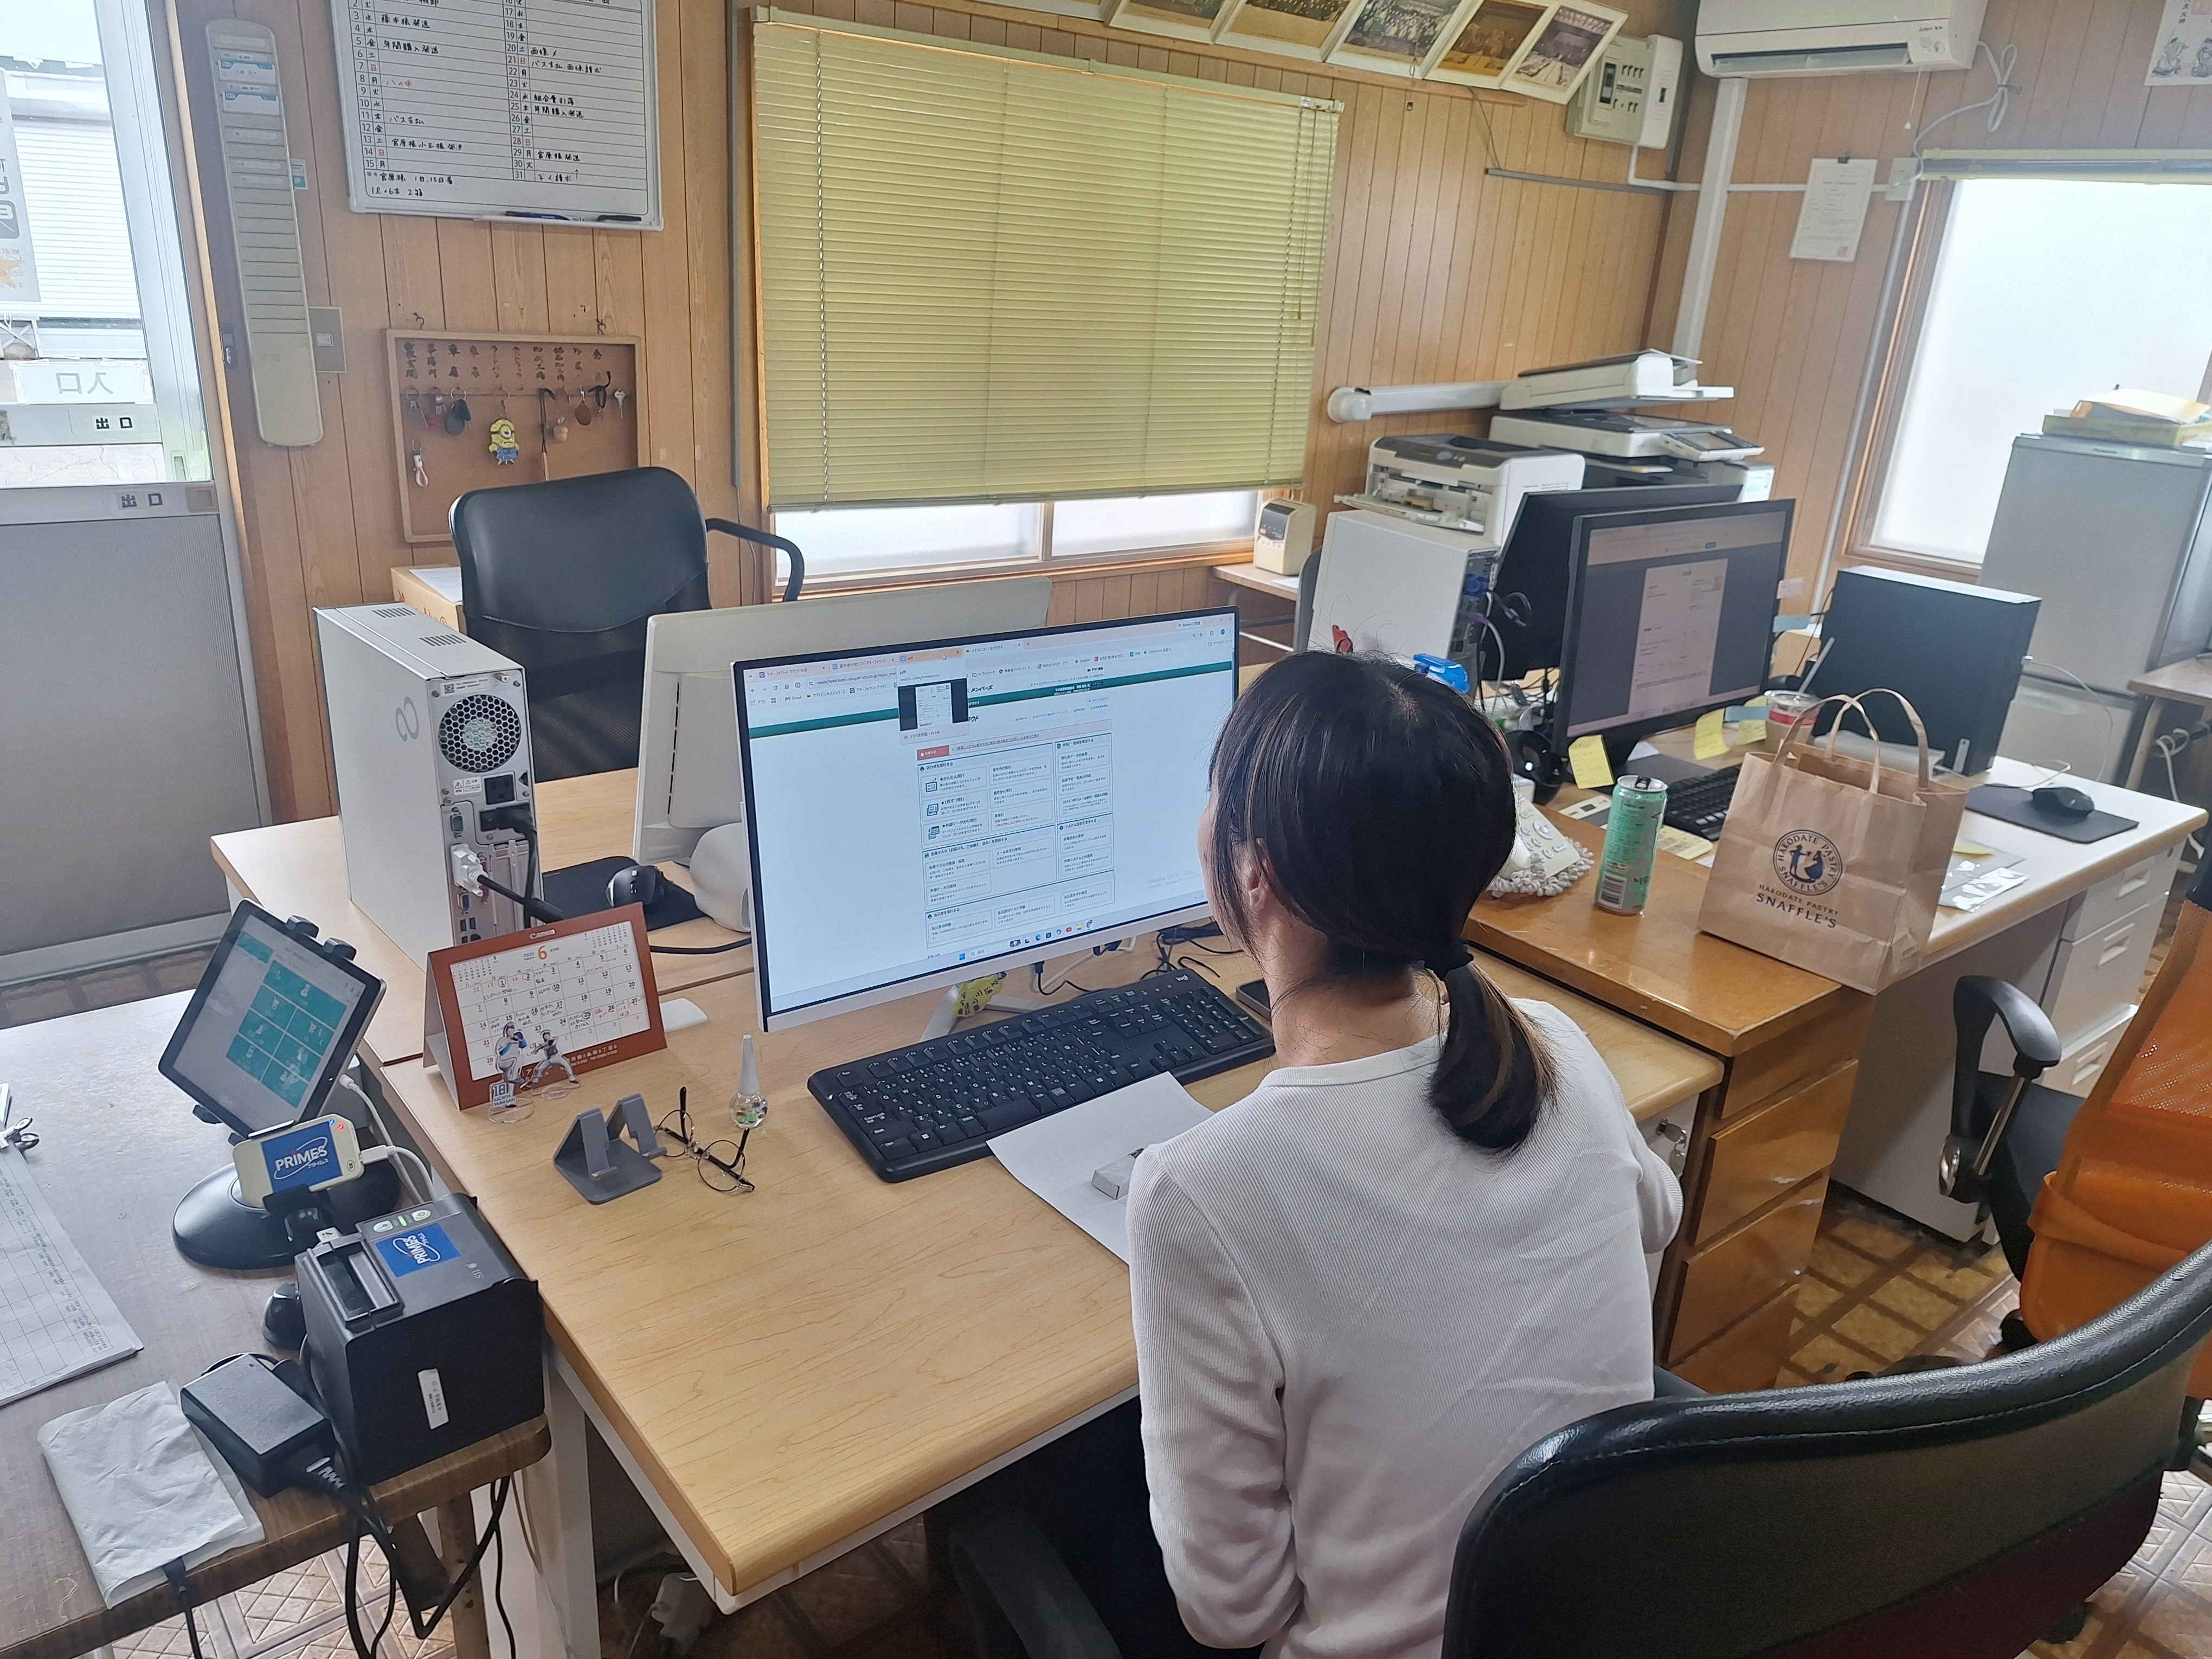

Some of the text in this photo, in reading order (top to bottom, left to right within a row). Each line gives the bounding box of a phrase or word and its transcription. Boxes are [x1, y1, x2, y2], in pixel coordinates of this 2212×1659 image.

[354, 11, 359, 20] 3
[357, 49, 363, 57] 6
[509, 67, 517, 75] 22
[510, 79, 518, 87] 23
[361, 87, 366, 95] 9
[510, 91, 518, 99] 24
[359, 99, 369, 107] 10
[361, 111, 370, 119] 11
[511, 114, 520, 122] 26
[362, 123, 371, 131] 12
[363, 136, 372, 144] 13
[365, 159, 375, 168] 15
[95, 417, 133, 430] 出口
[121, 493, 163, 508] 出口
[1778, 834, 1838, 880] HAKODATE PASTRY
[1779, 866, 1828, 891] SNAFFLE'S
[1759, 884, 1839, 916] HAKODATE PASTRY
[1756, 893, 1837, 928] SNAFFLE'S
[538, 946, 548, 960] 6
[493, 1084, 506, 1096] 18
[275, 1145, 328, 1172] PRIMES
[403, 1234, 430, 1265] PRIMES
